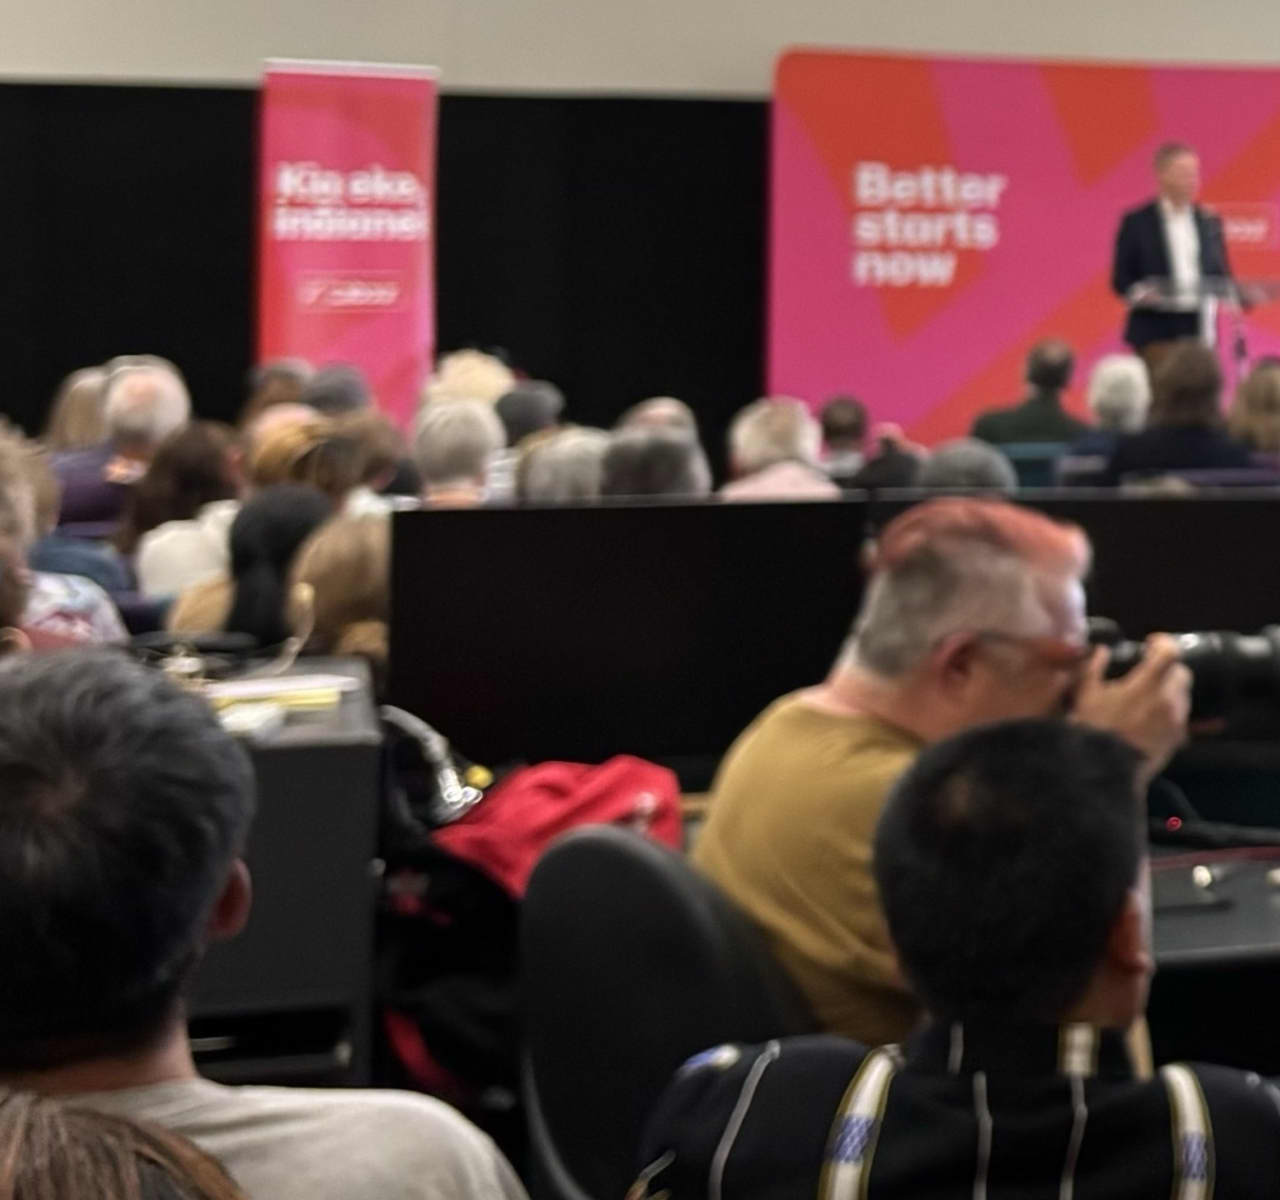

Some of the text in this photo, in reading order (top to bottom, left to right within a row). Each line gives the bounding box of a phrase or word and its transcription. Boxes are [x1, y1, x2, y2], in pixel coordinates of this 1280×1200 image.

[854, 161, 1008, 207] Better
[855, 209, 999, 250] starts
[854, 252, 957, 287] now
